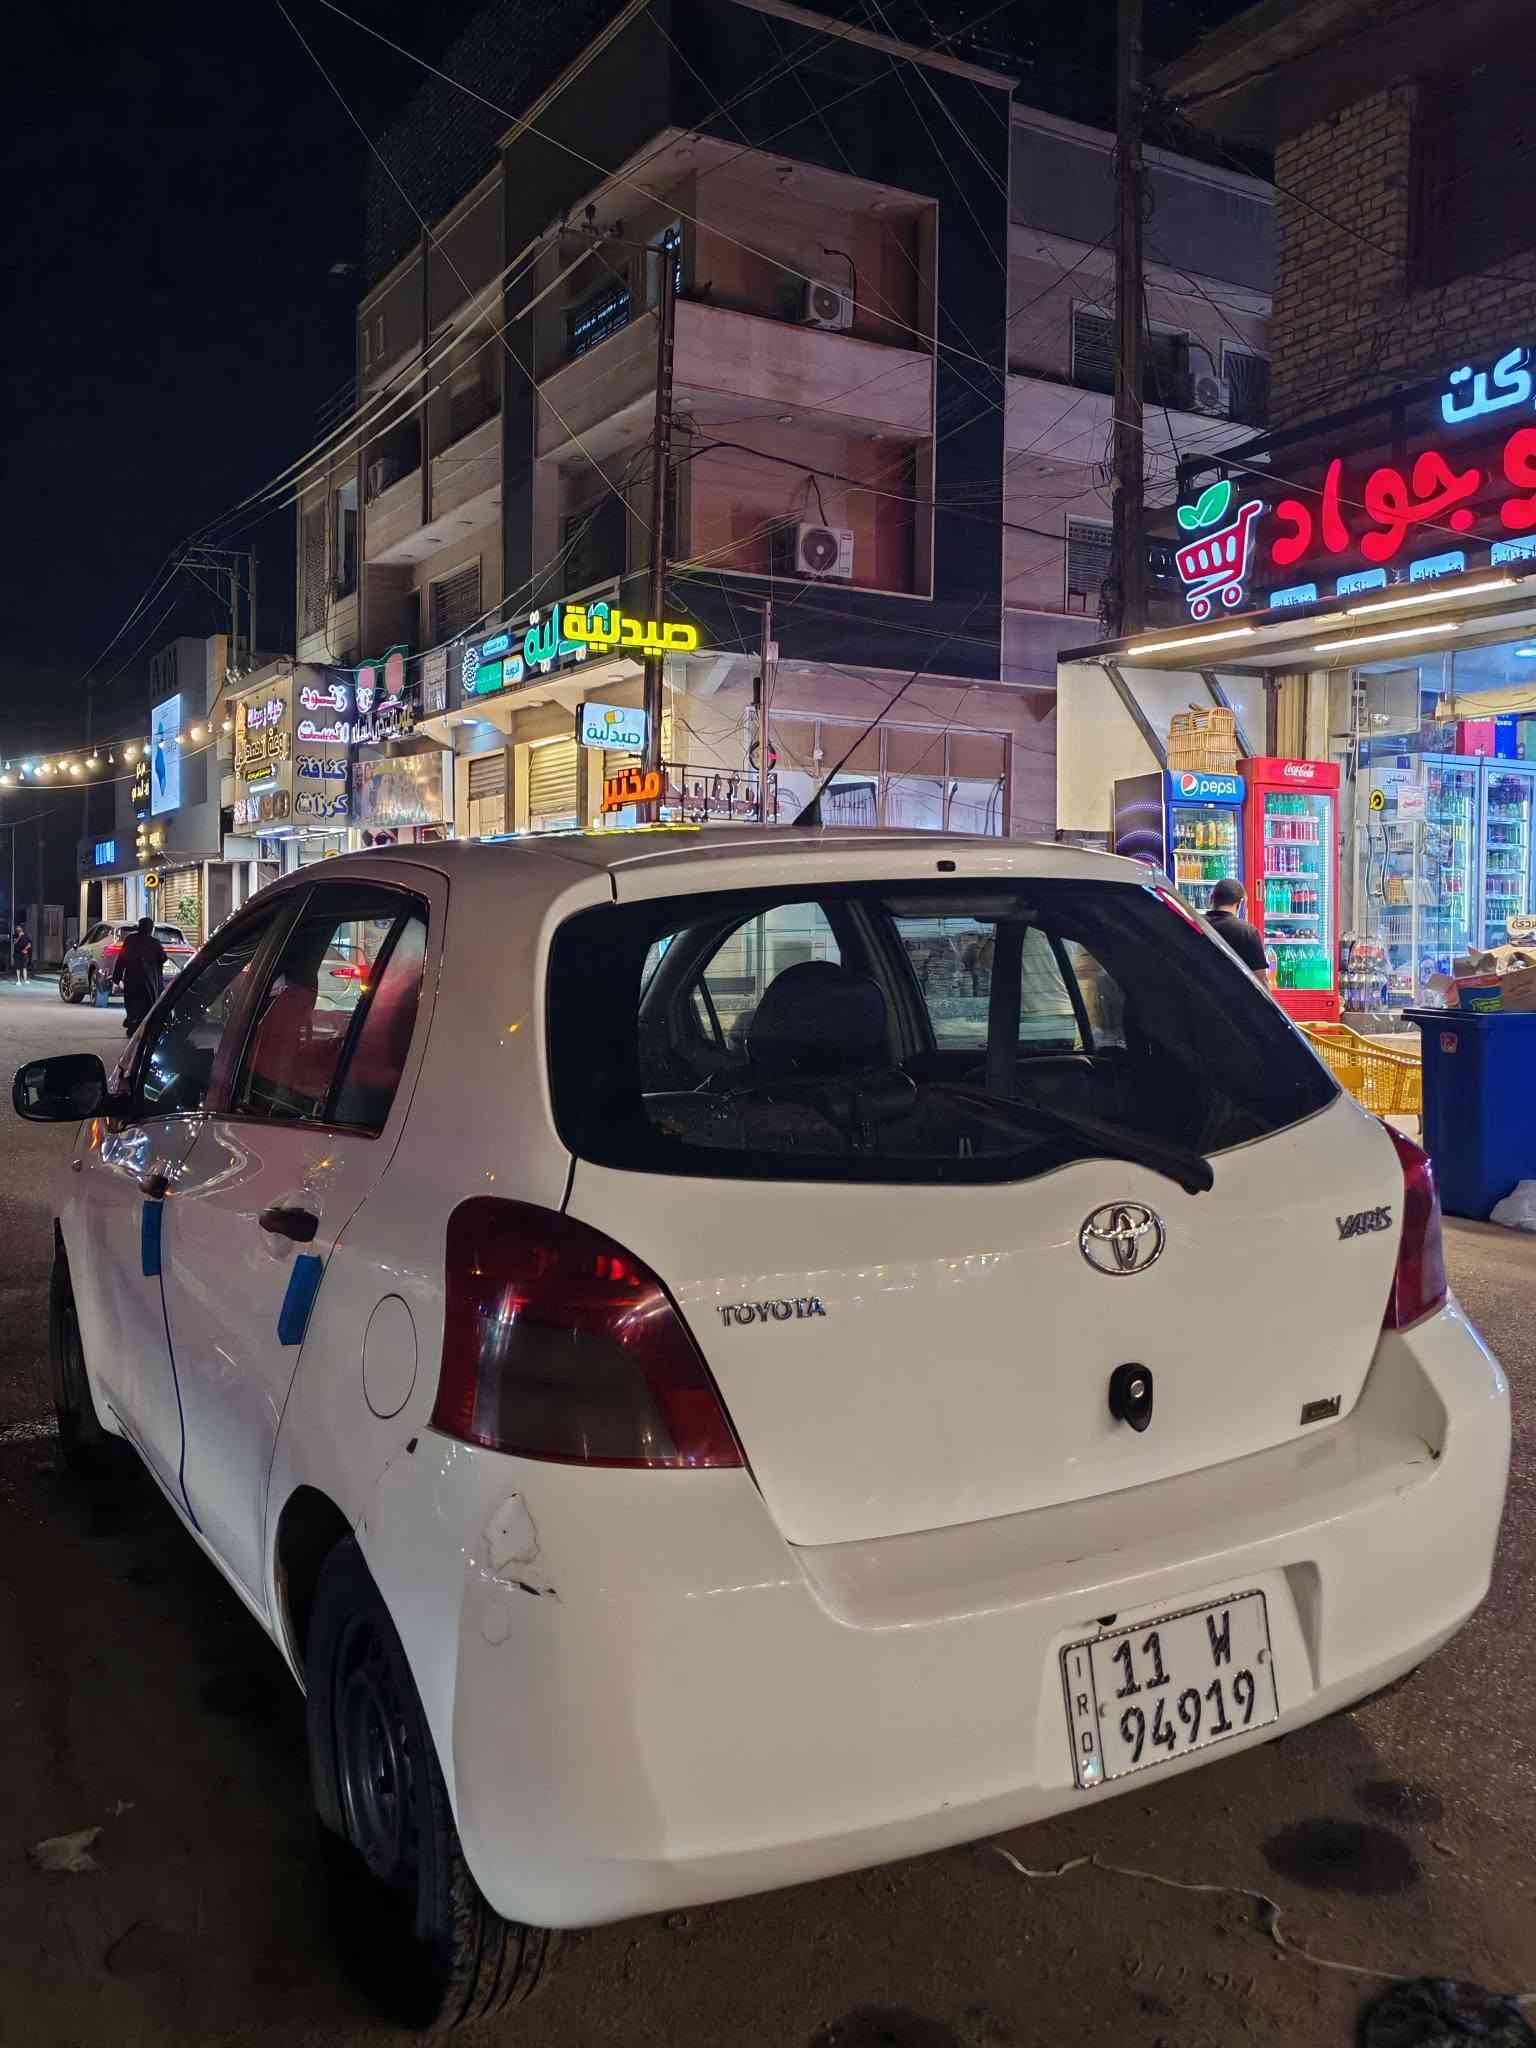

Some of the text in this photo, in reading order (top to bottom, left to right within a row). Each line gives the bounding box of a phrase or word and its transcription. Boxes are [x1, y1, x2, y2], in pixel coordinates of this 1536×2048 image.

[1441, 347, 1536, 423] كت
[563, 604, 698, 656] صيدلية
[586, 719, 641, 747] صيدلية
[297, 754, 348, 781] كنافة
[297, 791, 350, 818] كرزات
[599, 767, 661, 814] مختبر
[1199, 779, 1238, 797] pepsi
[1335, 1205, 1393, 1241] YARIS
[716, 1296, 827, 1328] TOYOTA
[1112, 1609, 1232, 1699] 11 W
[1119, 1668, 1256, 1764] 94919
